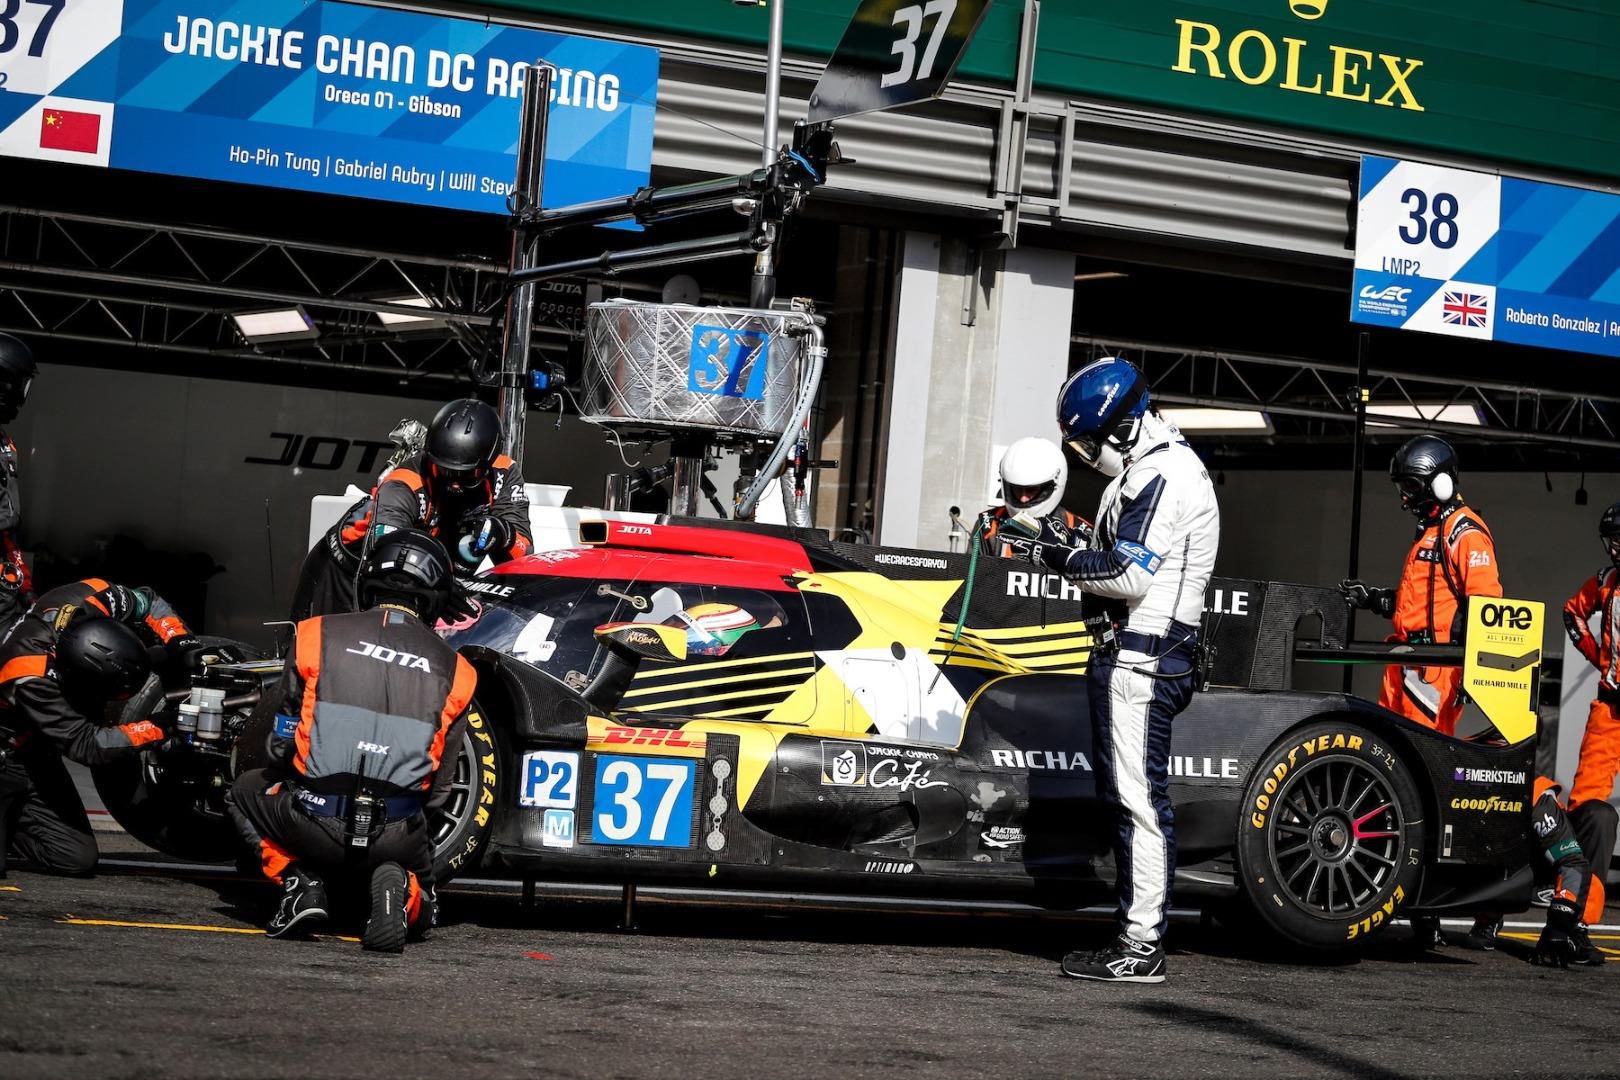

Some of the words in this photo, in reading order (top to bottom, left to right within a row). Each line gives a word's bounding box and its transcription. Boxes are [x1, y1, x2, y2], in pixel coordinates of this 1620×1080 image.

[164, 15, 304, 69] JACKIE
[315, 34, 416, 85] CHAN
[427, 49, 475, 92] DC
[881, 0, 957, 88] 37
[1171, 18, 1425, 111] ROLEX
[325, 84, 370, 106] Oreca
[374, 90, 394, 109] 07
[408, 95, 461, 118] Gibson
[229, 145, 279, 167] Ho-Pin
[285, 152, 320, 177] Tung
[335, 158, 388, 181] Gabriel
[391, 165, 435, 191] Aubry
[449, 172, 476, 192] Will
[1398, 188, 1460, 249] 38
[1382, 256, 1421, 277] LMP2
[541, 282, 582, 294] JOTA
[1506, 308, 1549, 327] Roberto
[1552, 313, 1600, 334] Gonzalez
[695, 331, 766, 393] 37
[617, 525, 653, 536] JOTA
[875, 554, 948, 569] #WECRACESFORYOU
[1481, 603, 1533, 630] one
[346, 641, 431, 673] JOTA
[1473, 679, 1506, 688] RICHARD
[1507, 682, 1528, 690] MILLE
[357, 740, 390, 755] HRX
[602, 726, 691, 748] DHL
[868, 746, 903, 757] JACKIE
[526, 759, 572, 801] P2
[869, 758, 949, 791] Café
[1252, 734, 1363, 829] GOODYEAR
[598, 760, 688, 841] 37
[1451, 796, 1523, 814] GOODYEAR
[550, 815, 570, 837] M
[1346, 884, 1406, 940] EAGLE
